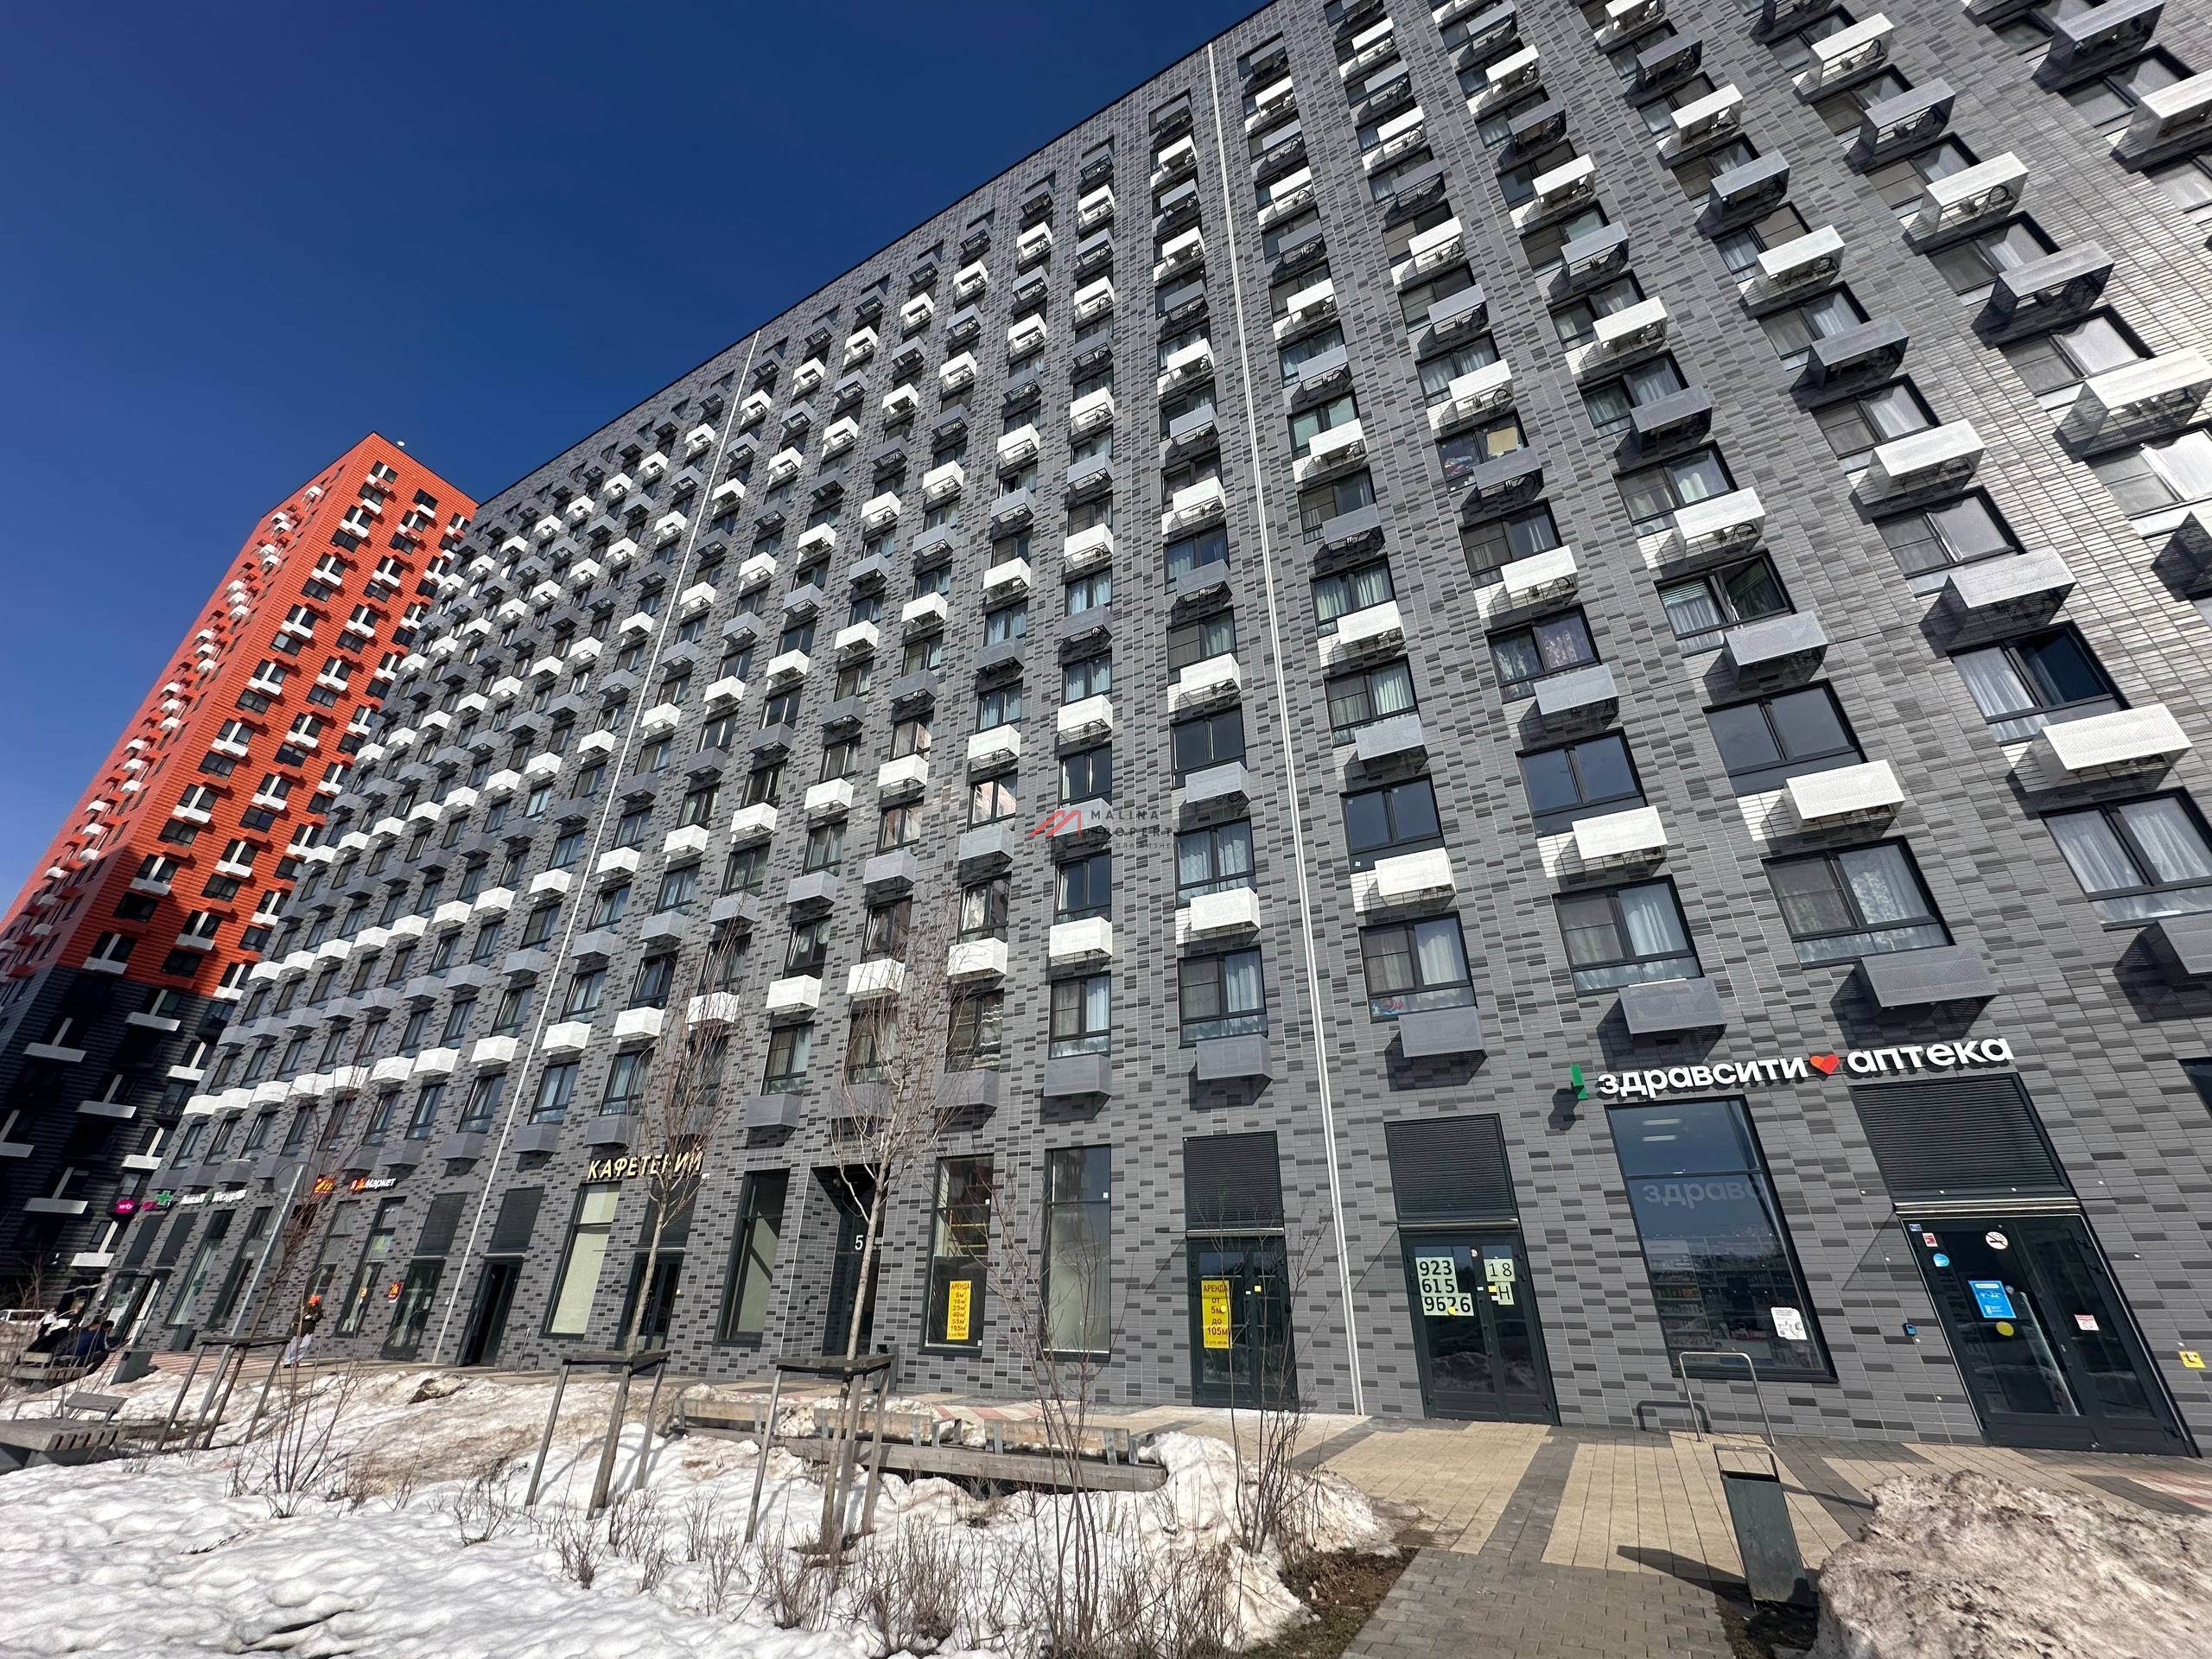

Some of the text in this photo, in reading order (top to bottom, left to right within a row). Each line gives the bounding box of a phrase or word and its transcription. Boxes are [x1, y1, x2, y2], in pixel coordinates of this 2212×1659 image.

[1598, 1038, 2015, 1099] здравсити аптека
[362, 1178, 397, 1189] Маркет
[855, 1235, 863, 1250] 5
[1420, 1260, 1452, 1276] 923
[1204, 1284, 1228, 1293] АРЕНДА
[1422, 1278, 1455, 1293] 615
[1424, 1296, 1471, 1313] 9626
